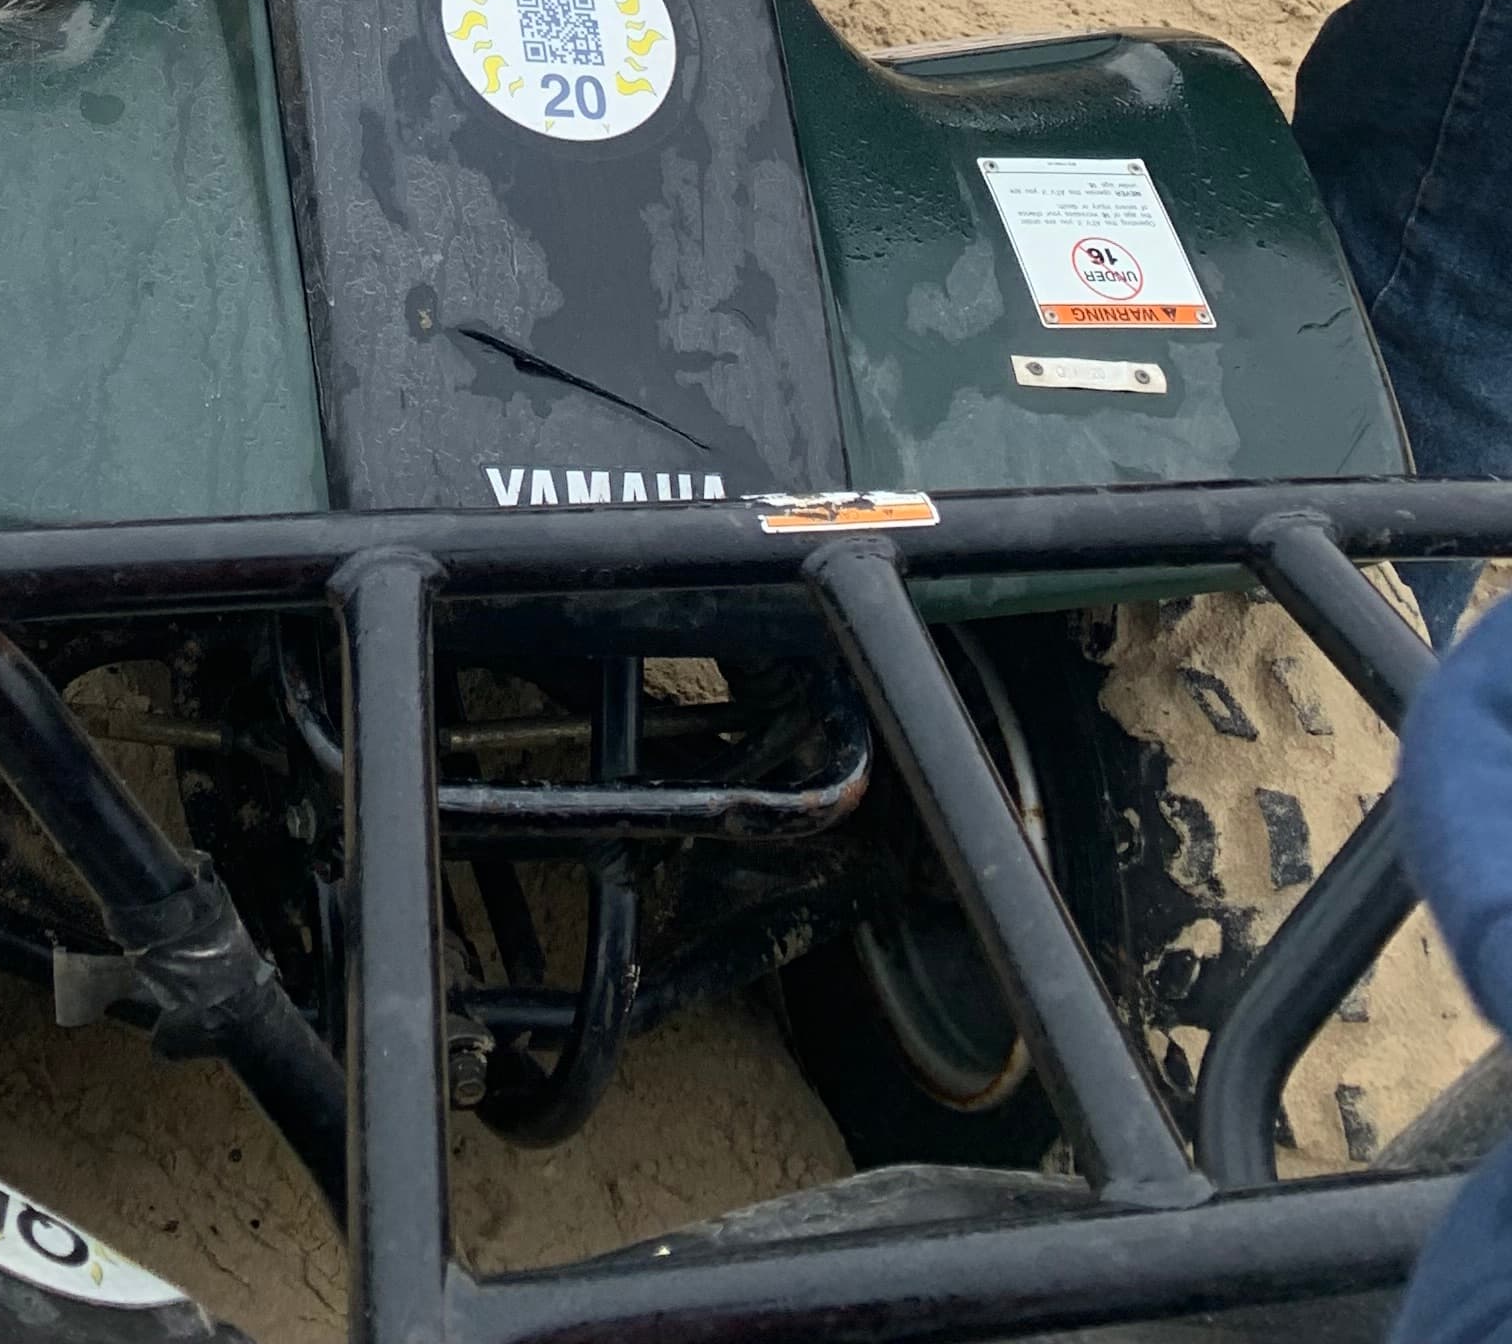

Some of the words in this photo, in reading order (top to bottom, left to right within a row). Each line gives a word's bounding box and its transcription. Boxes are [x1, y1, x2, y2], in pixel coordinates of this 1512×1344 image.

[541, 73, 607, 120] 20
[1087, 247, 1118, 266] 16
[1083, 270, 1138, 283] UNDER
[1071, 307, 1160, 322] WARNING
